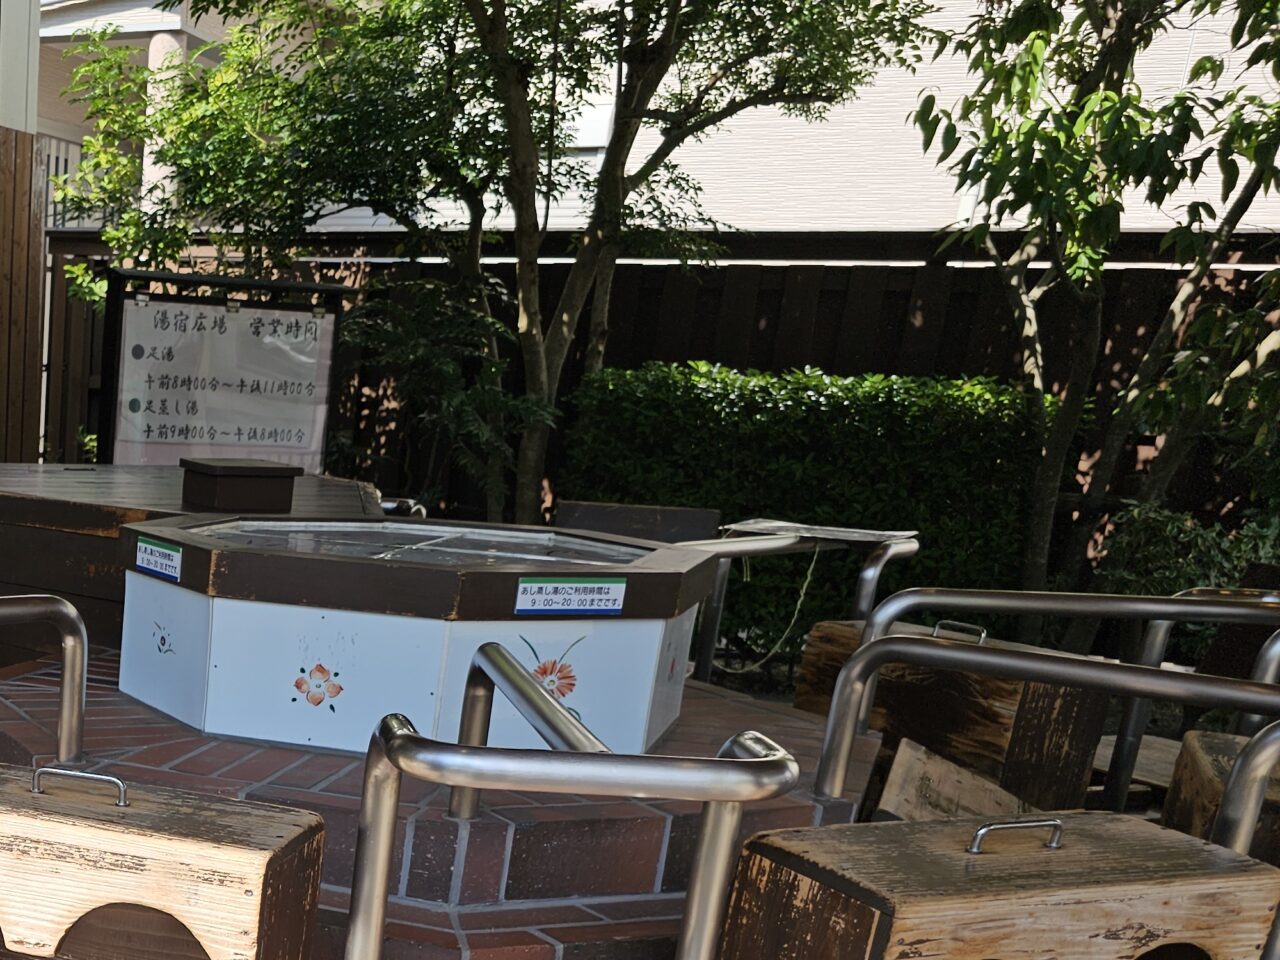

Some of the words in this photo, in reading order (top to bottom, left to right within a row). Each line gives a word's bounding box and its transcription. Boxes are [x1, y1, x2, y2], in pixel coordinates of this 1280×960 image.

[153, 310, 228, 335] 湯宿広場
[249, 317, 318, 342] 営業時間
[146, 346, 175, 362] 足湯
[143, 400, 199, 416] 足蒸し湯
[521, 586, 610, 596] あし蒸し湯のご利用時間は
